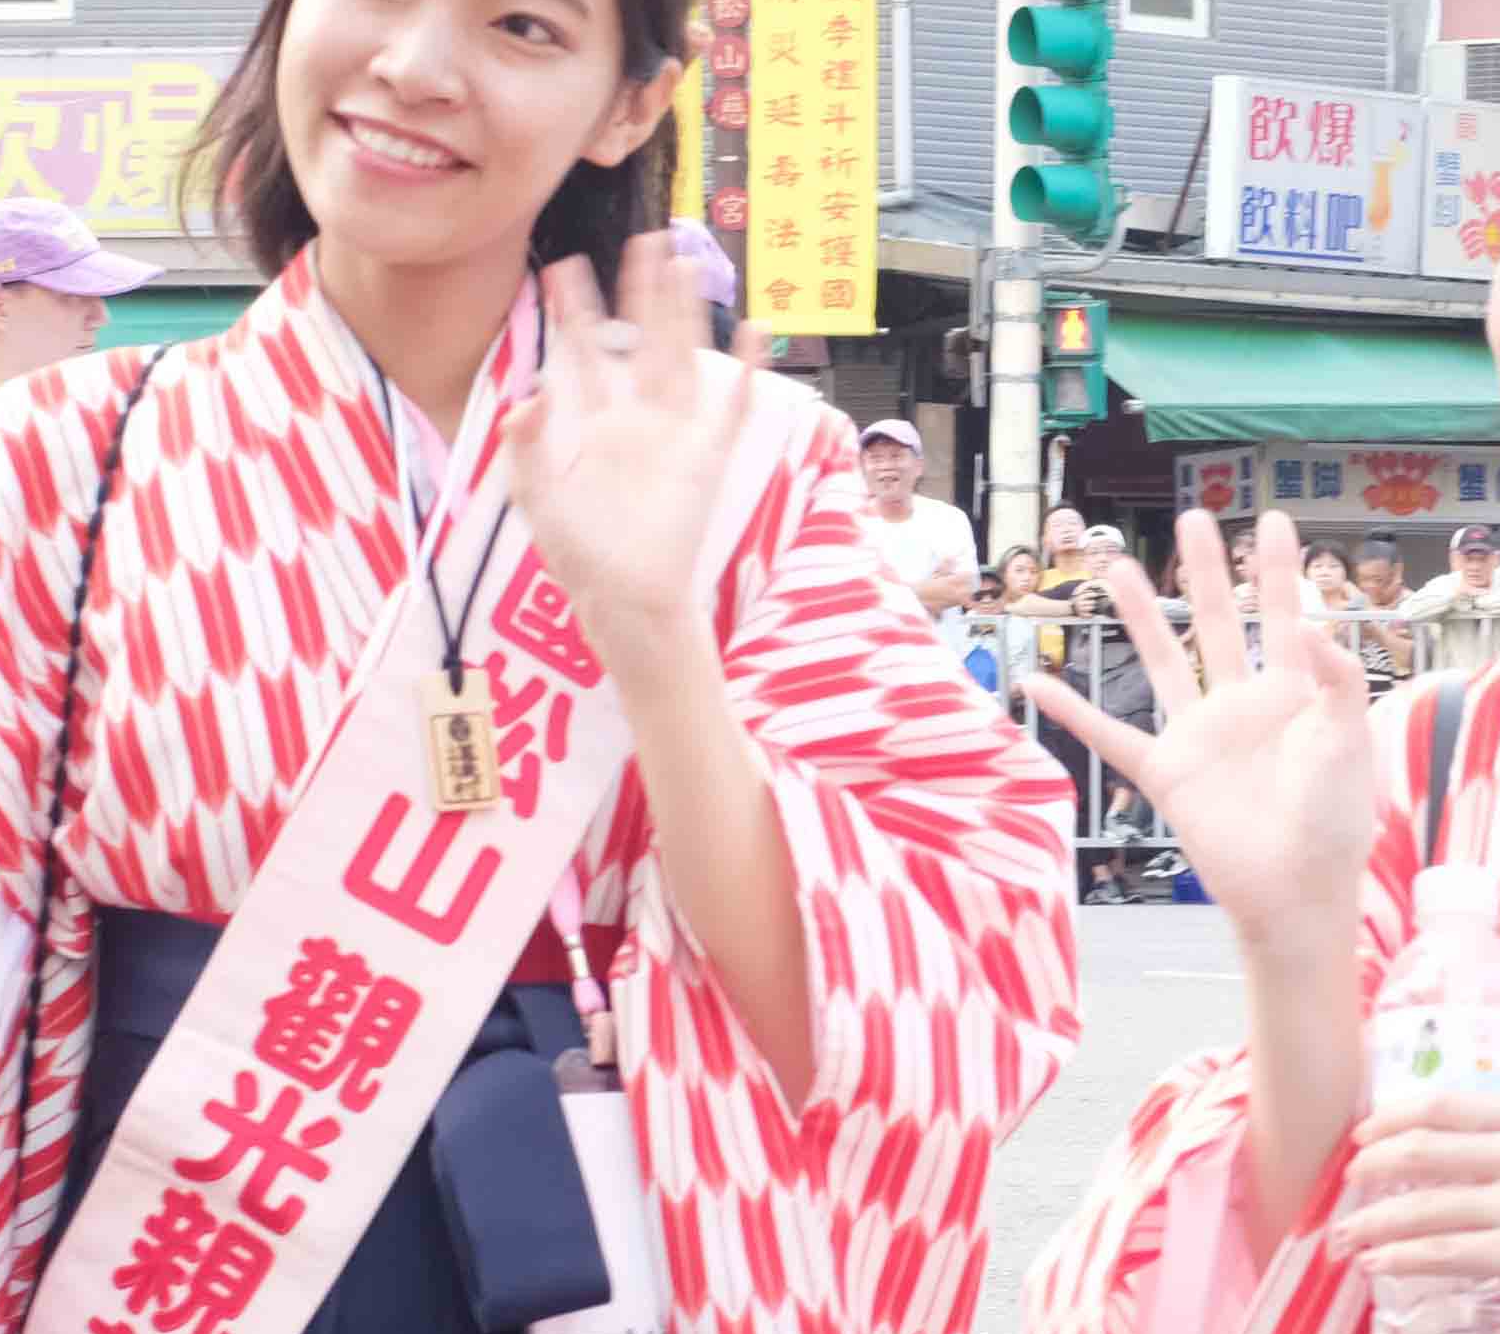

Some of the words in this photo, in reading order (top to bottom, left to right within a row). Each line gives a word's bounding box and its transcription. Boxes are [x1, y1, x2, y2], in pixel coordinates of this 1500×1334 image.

[1248, 95, 1355, 167] 飲爆
[1239, 185, 1365, 254] 飲料吧
